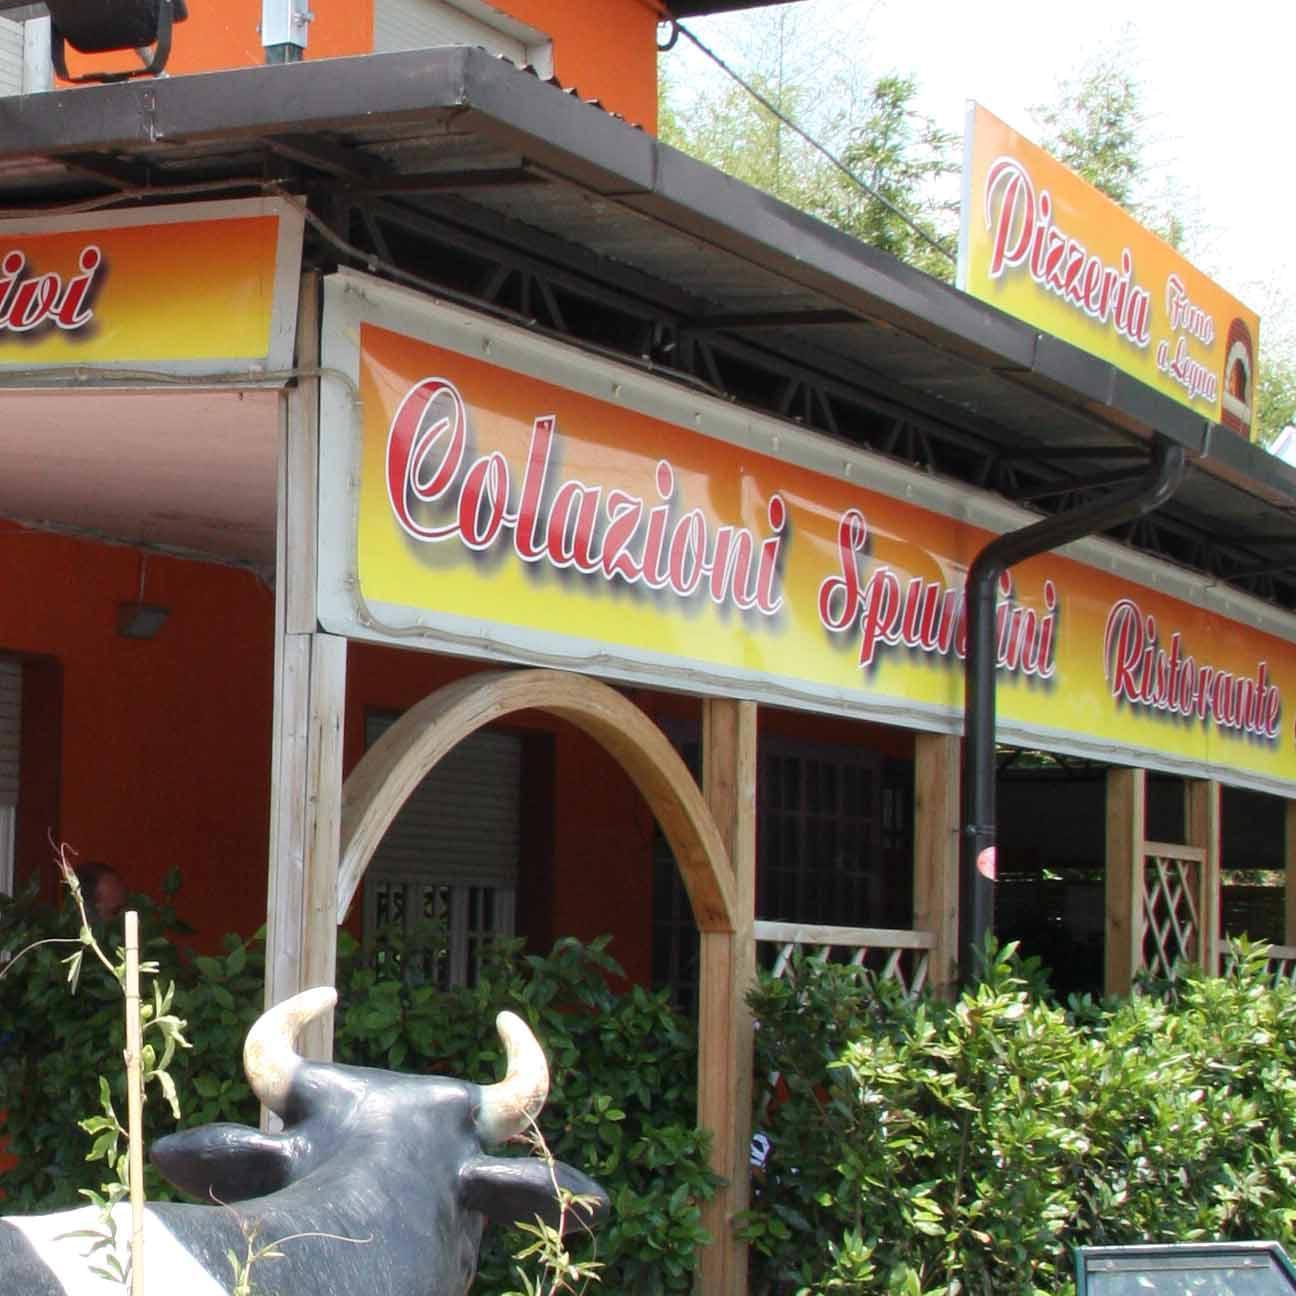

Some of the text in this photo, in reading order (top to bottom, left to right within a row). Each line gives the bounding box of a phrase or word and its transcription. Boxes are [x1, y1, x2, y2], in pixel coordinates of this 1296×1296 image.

[984, 156, 1152, 348] Pizzeria
[384, 375, 1281, 739] Colazioni Spunini Ristorante
